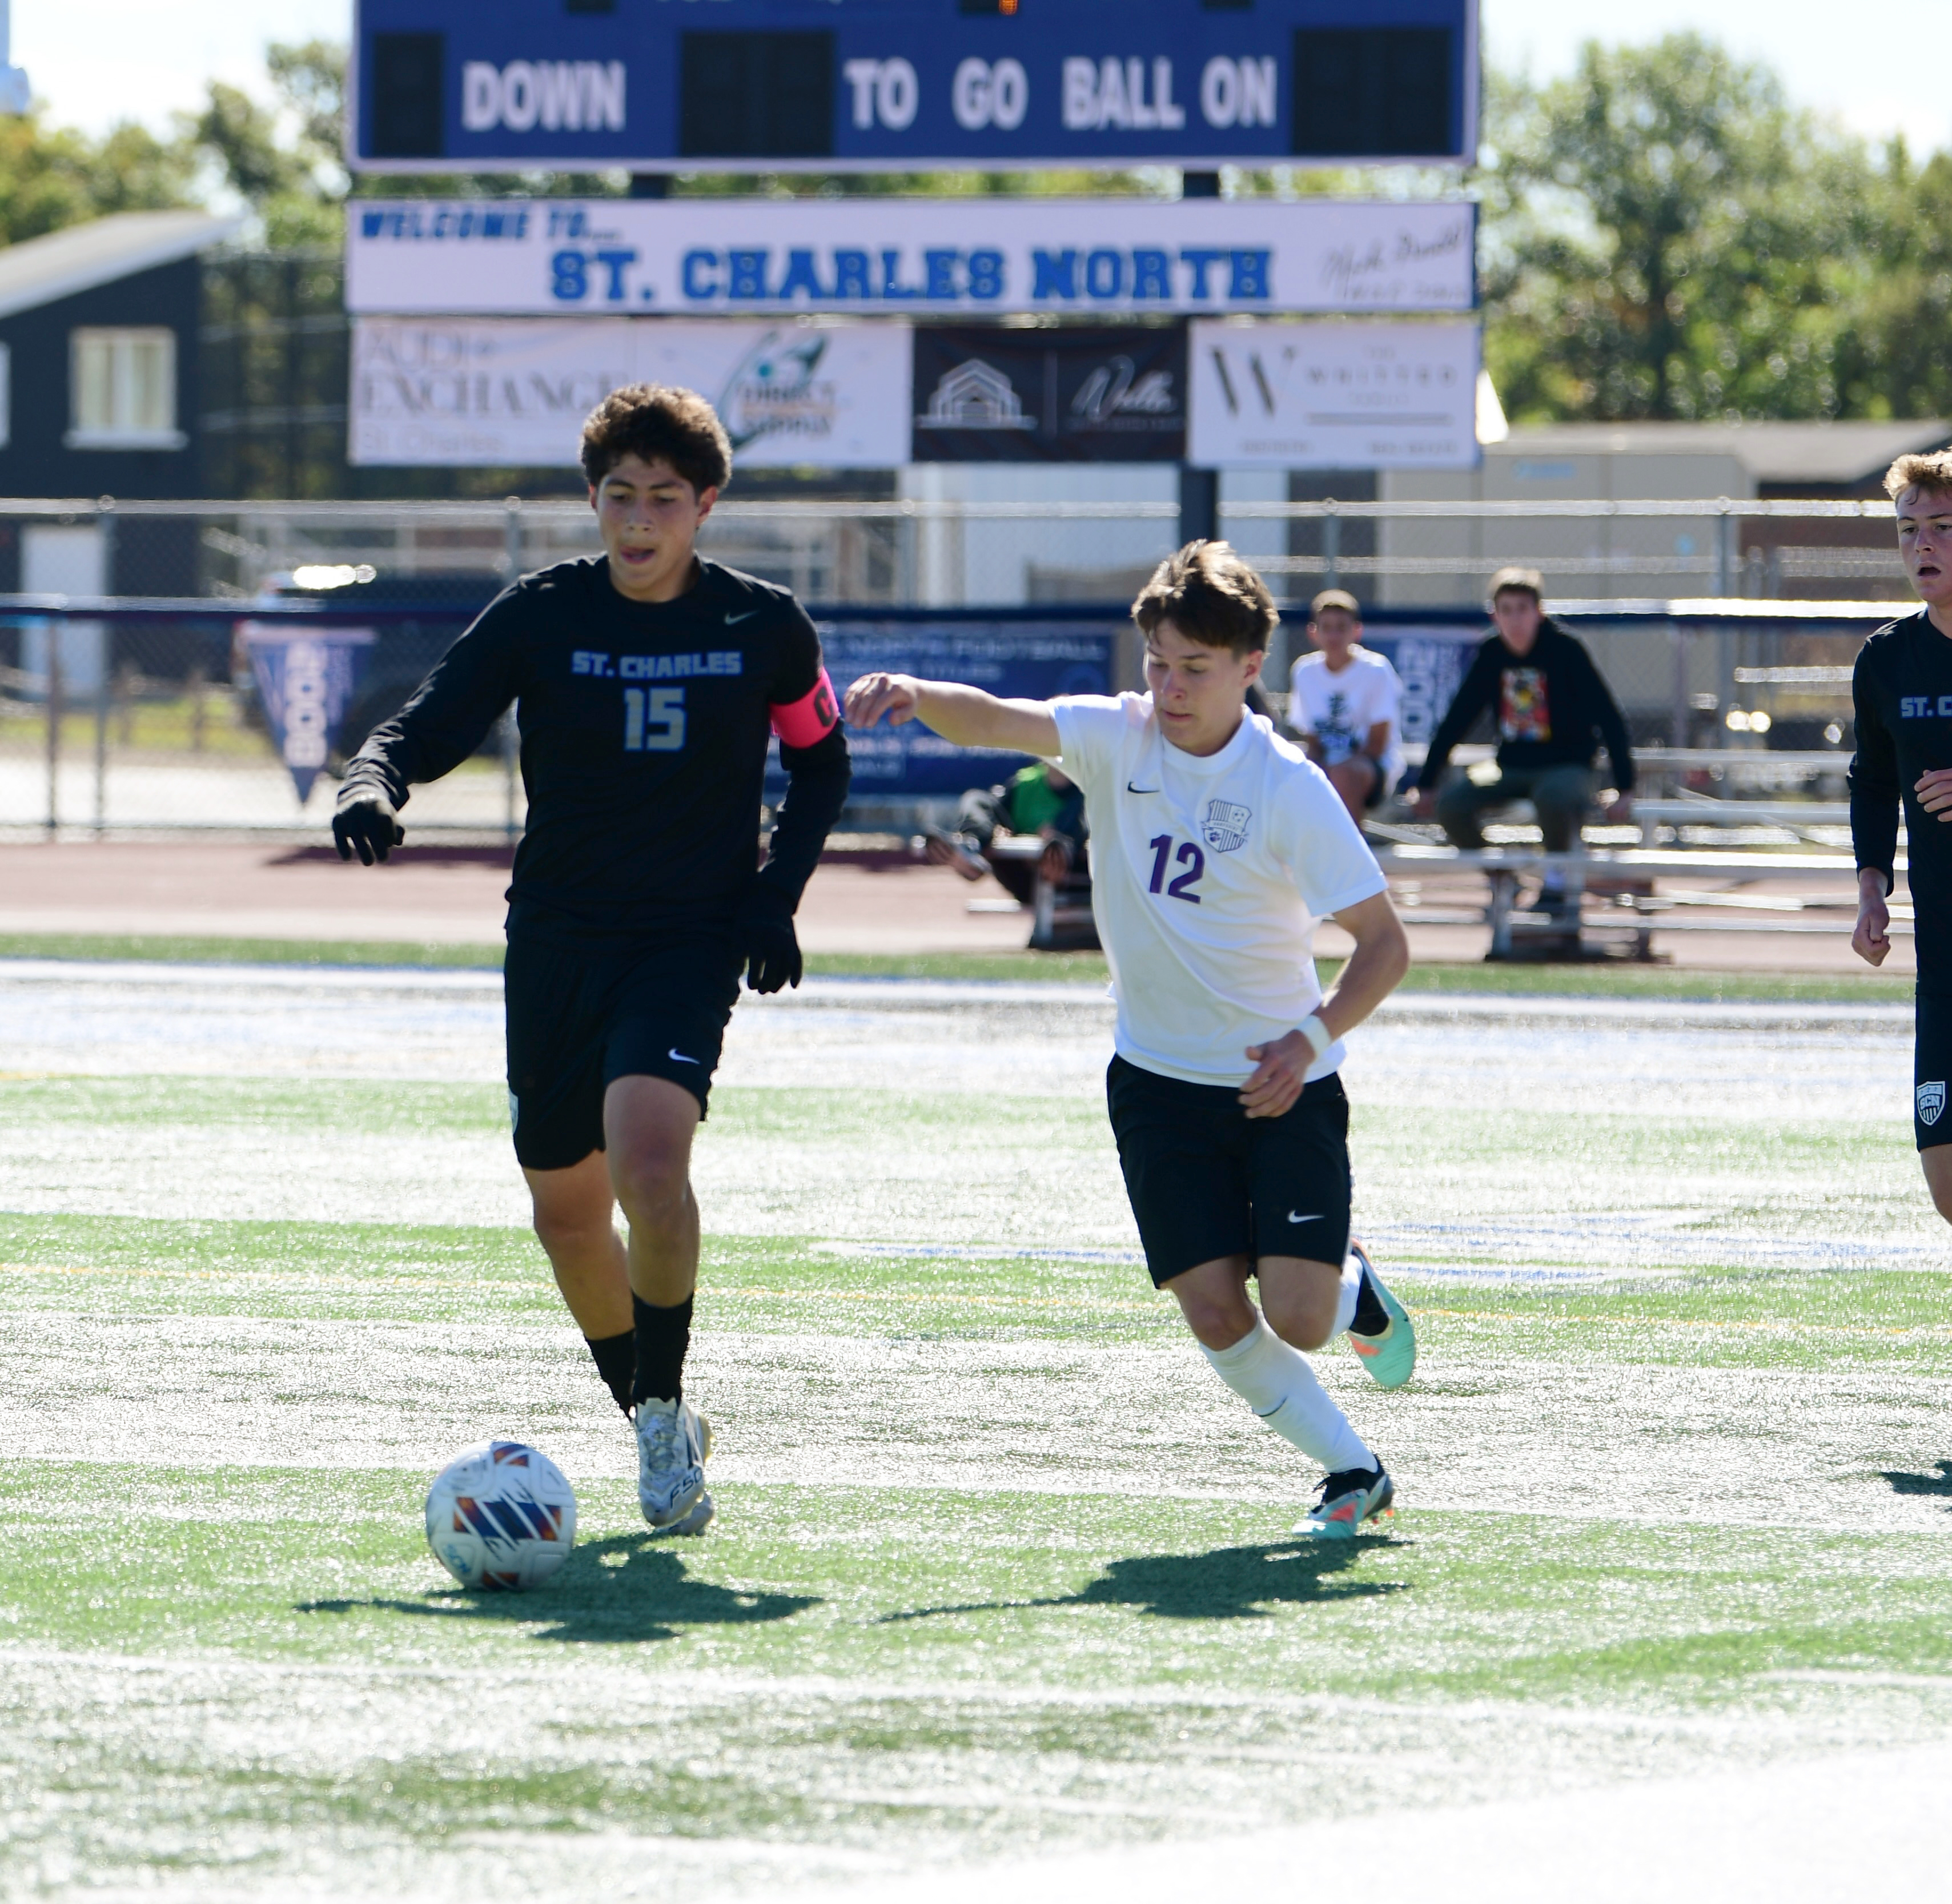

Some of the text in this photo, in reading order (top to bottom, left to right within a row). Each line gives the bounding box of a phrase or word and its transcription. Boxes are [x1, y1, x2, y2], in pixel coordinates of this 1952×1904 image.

[461, 60, 626, 131] DOWN
[844, 57, 1029, 131] TO GO
[1062, 57, 1278, 130] BALL ON
[362, 211, 529, 239] WELCOME
[552, 250, 656, 300] ST.
[681, 250, 1003, 299] CHARLES
[1031, 250, 1271, 299] NORTH
[572, 650, 742, 679] ST. CHARLES
[624, 687, 686, 752] 15
[815, 686, 833, 727] C
[1900, 696, 1934, 718] ST.
[1150, 834, 1204, 905] 12
[1920, 1095, 1941, 1110] SCN
